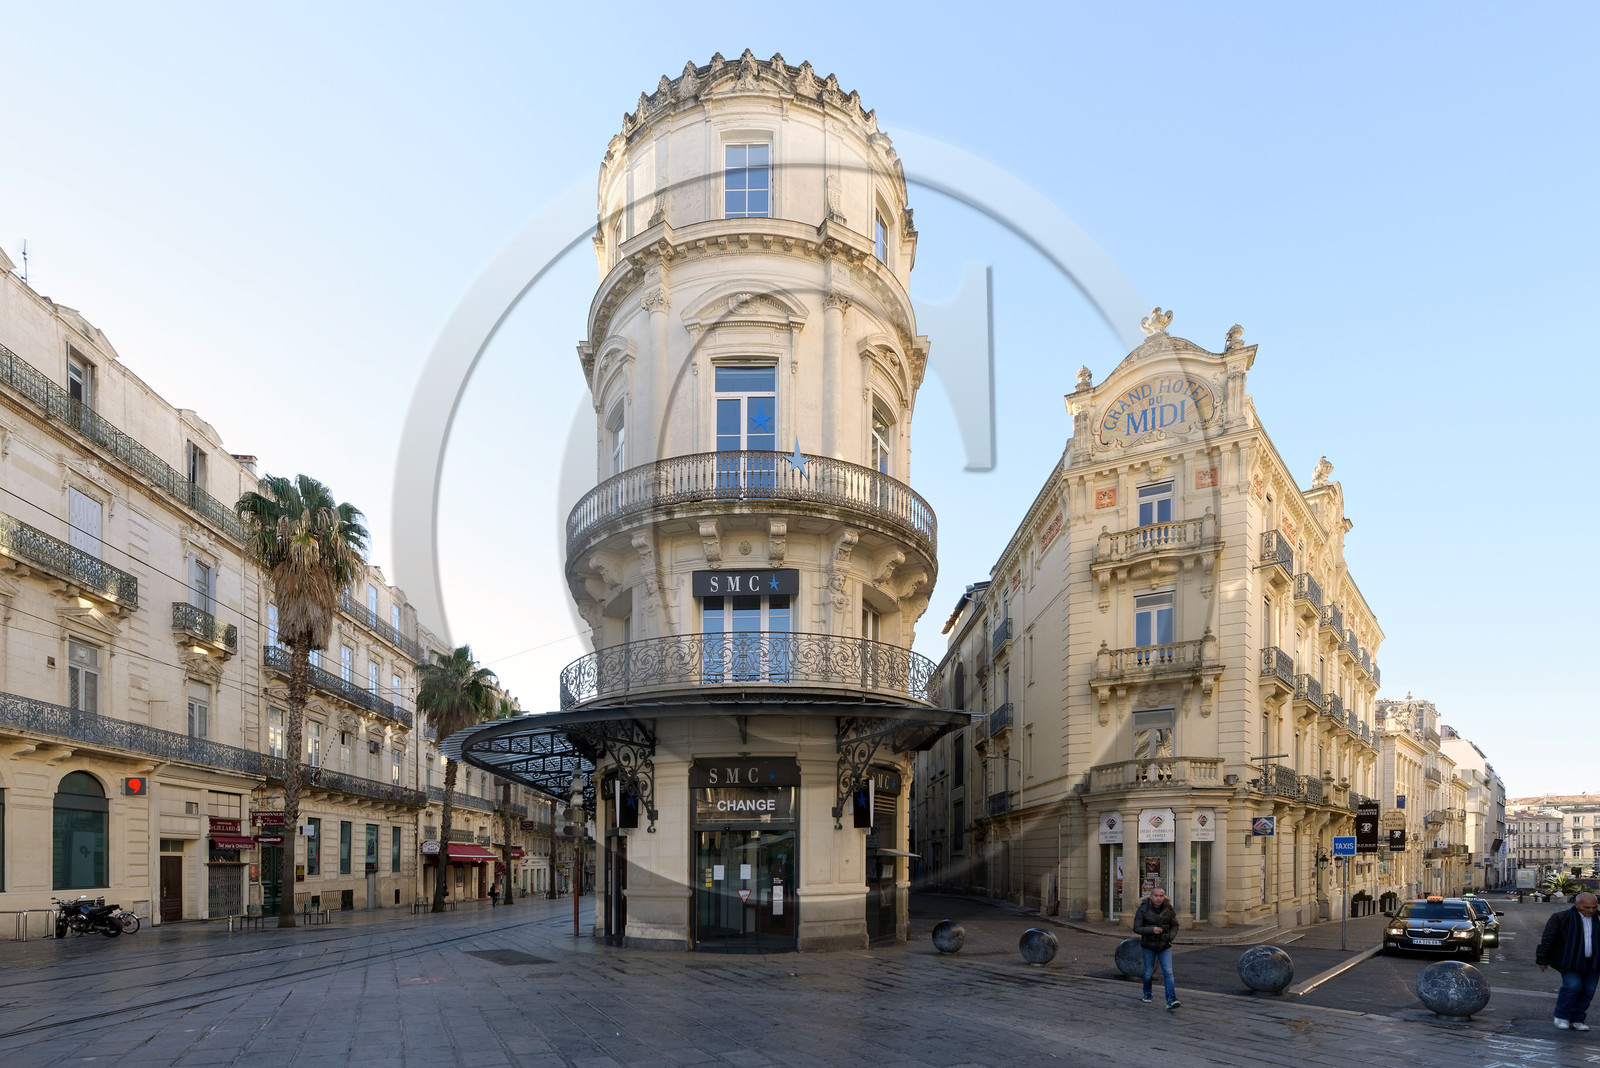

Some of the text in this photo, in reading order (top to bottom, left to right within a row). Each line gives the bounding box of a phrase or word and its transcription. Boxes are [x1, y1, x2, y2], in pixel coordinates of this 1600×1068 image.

[1103, 379, 1208, 430] GRAND HOTEL
[1148, 396, 1163, 407] DU
[1126, 400, 1187, 436] MIDI
[717, 799, 776, 812] CHANGE
